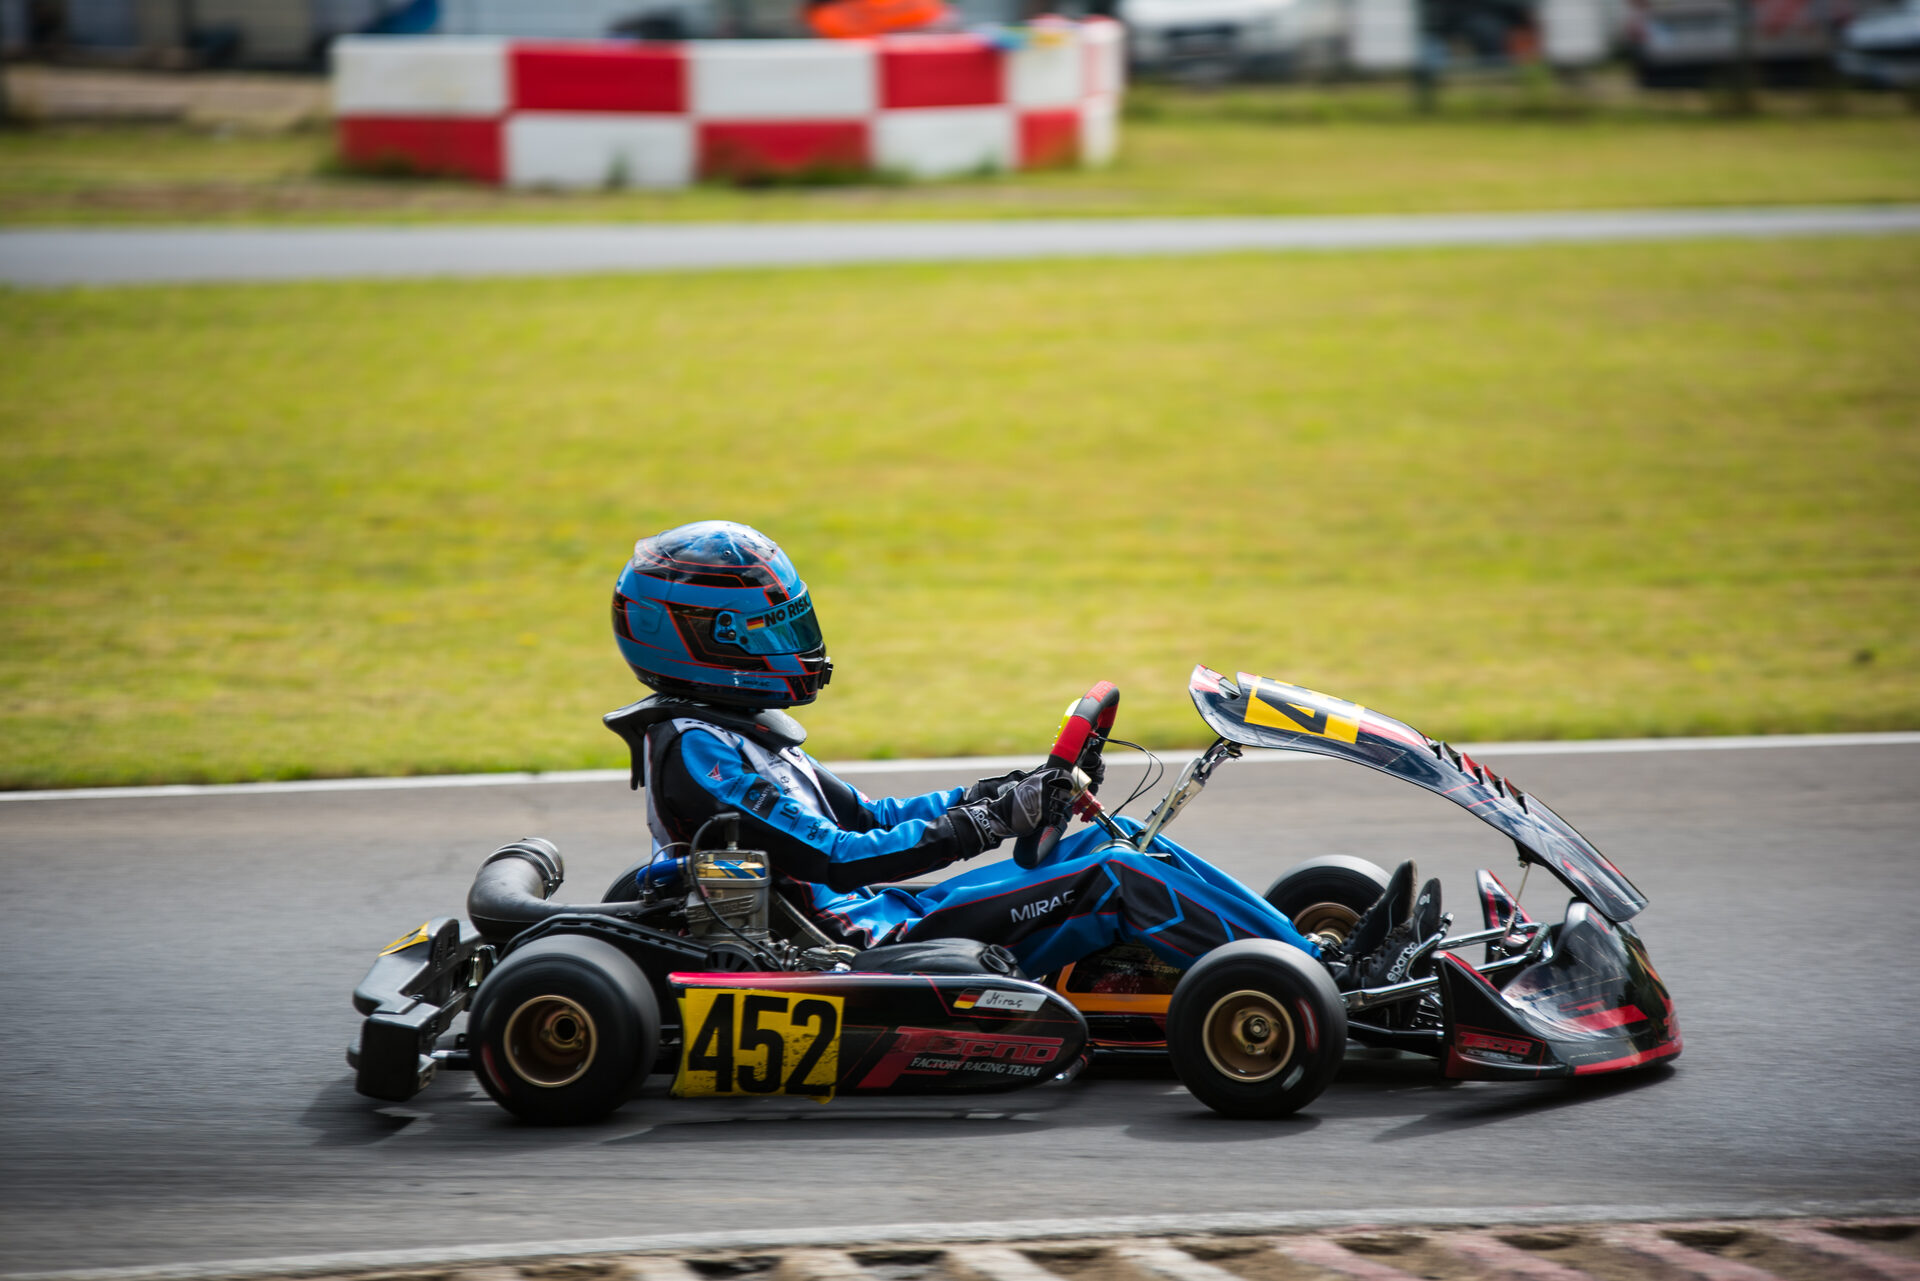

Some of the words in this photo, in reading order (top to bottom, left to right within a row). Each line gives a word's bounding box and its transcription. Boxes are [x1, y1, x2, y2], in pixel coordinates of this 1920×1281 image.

[764, 608, 786, 627] NO
[787, 595, 810, 618] RISK
[687, 993, 838, 1097] 452
[910, 1057, 963, 1070] FACTORY
[963, 1061, 1006, 1074] RACING
[1007, 1064, 1042, 1078] TEAM
